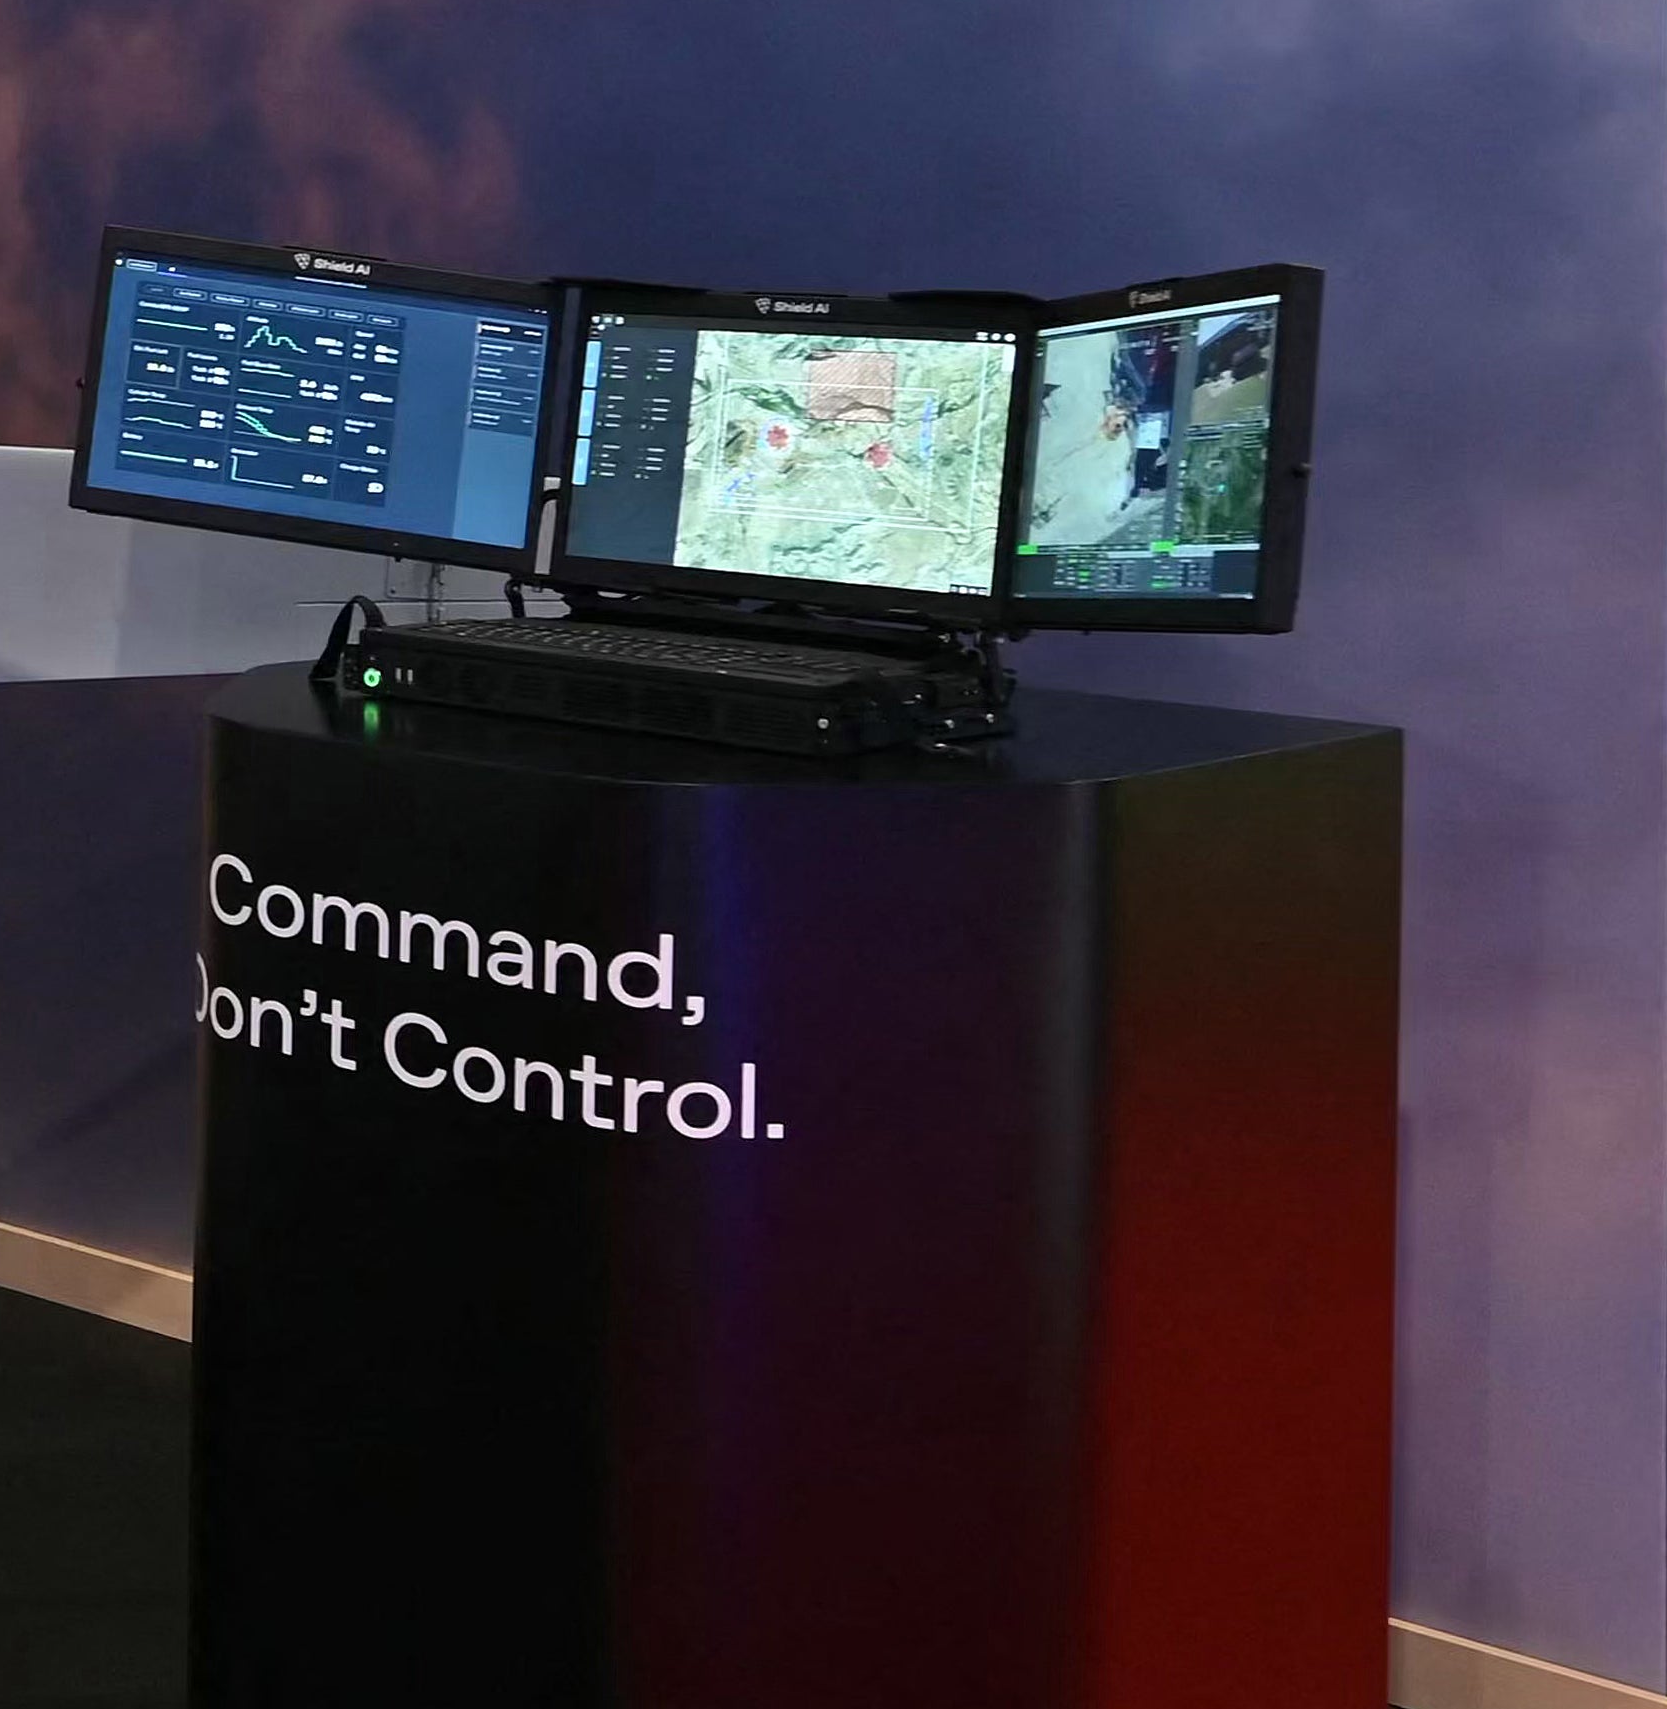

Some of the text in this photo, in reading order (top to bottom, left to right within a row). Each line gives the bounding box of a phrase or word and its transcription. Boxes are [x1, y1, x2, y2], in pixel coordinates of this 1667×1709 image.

[313, 258, 371, 276] Shield AI
[208, 853, 705, 1025] Command,
[383, 1011, 785, 1140] Control.
